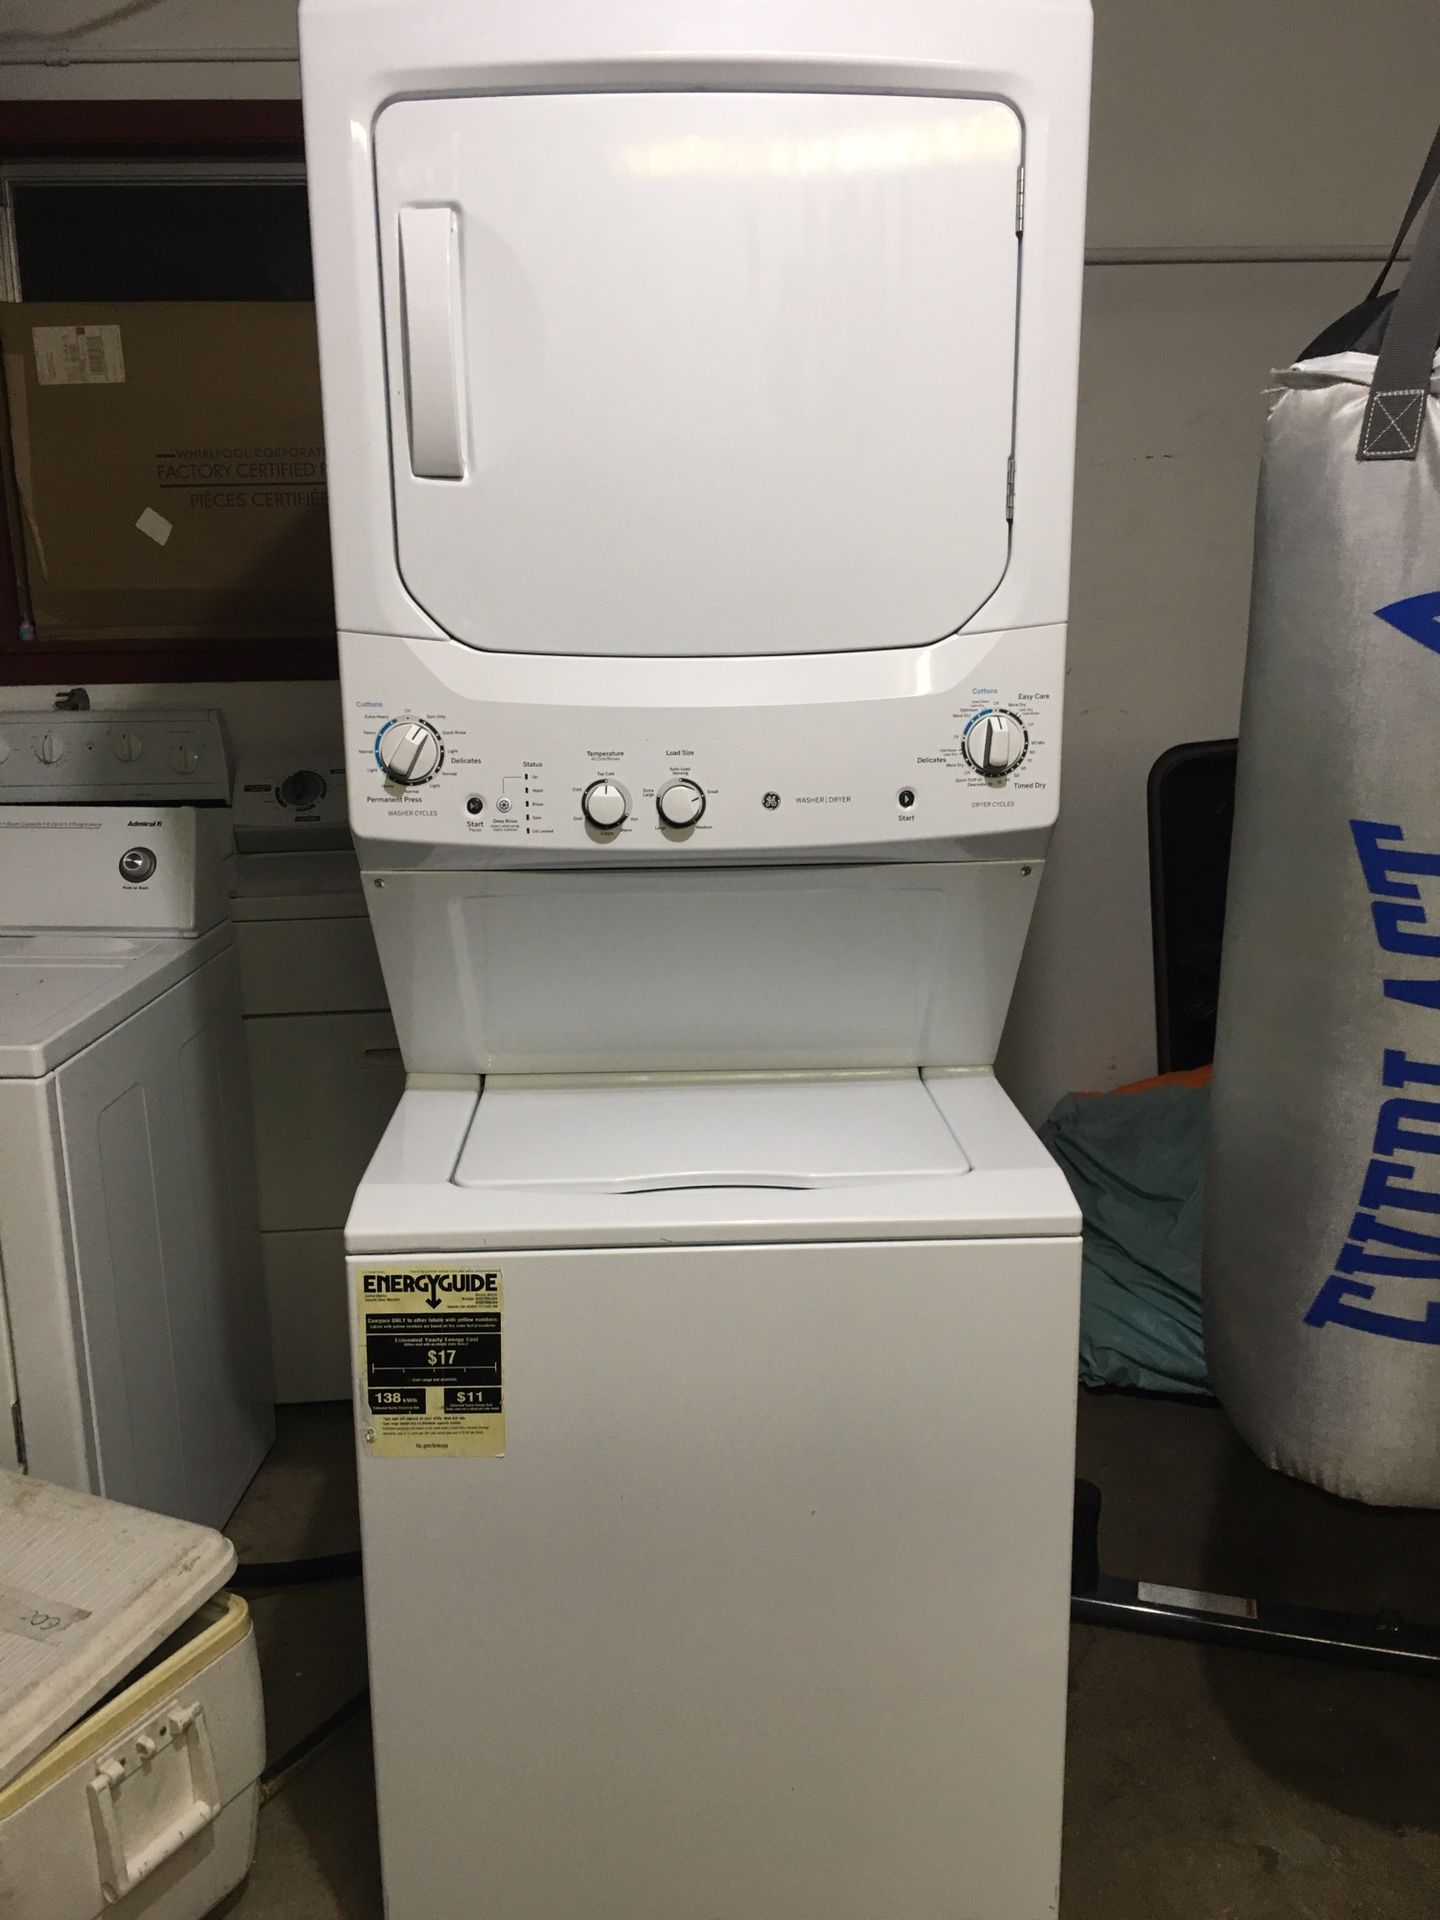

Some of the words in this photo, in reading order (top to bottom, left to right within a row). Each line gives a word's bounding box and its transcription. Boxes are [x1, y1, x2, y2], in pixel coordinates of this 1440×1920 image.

[177, 448, 250, 459] WHIRLPOOL
[157, 463, 232, 480] FACTORY
[236, 462, 315, 478] CERTIFIED
[190, 490, 246, 508] PIÈCES
[1018, 693, 1033, 701] Easy
[1034, 693, 1050, 701] Care
[587, 750, 624, 758] Temperature
[1014, 782, 1033, 790] Timed
[1034, 782, 1046, 790] Dry
[428, 1350, 456, 1366] $17
[375, 1393, 402, 1403] 138
[457, 1392, 483, 1403] $11
